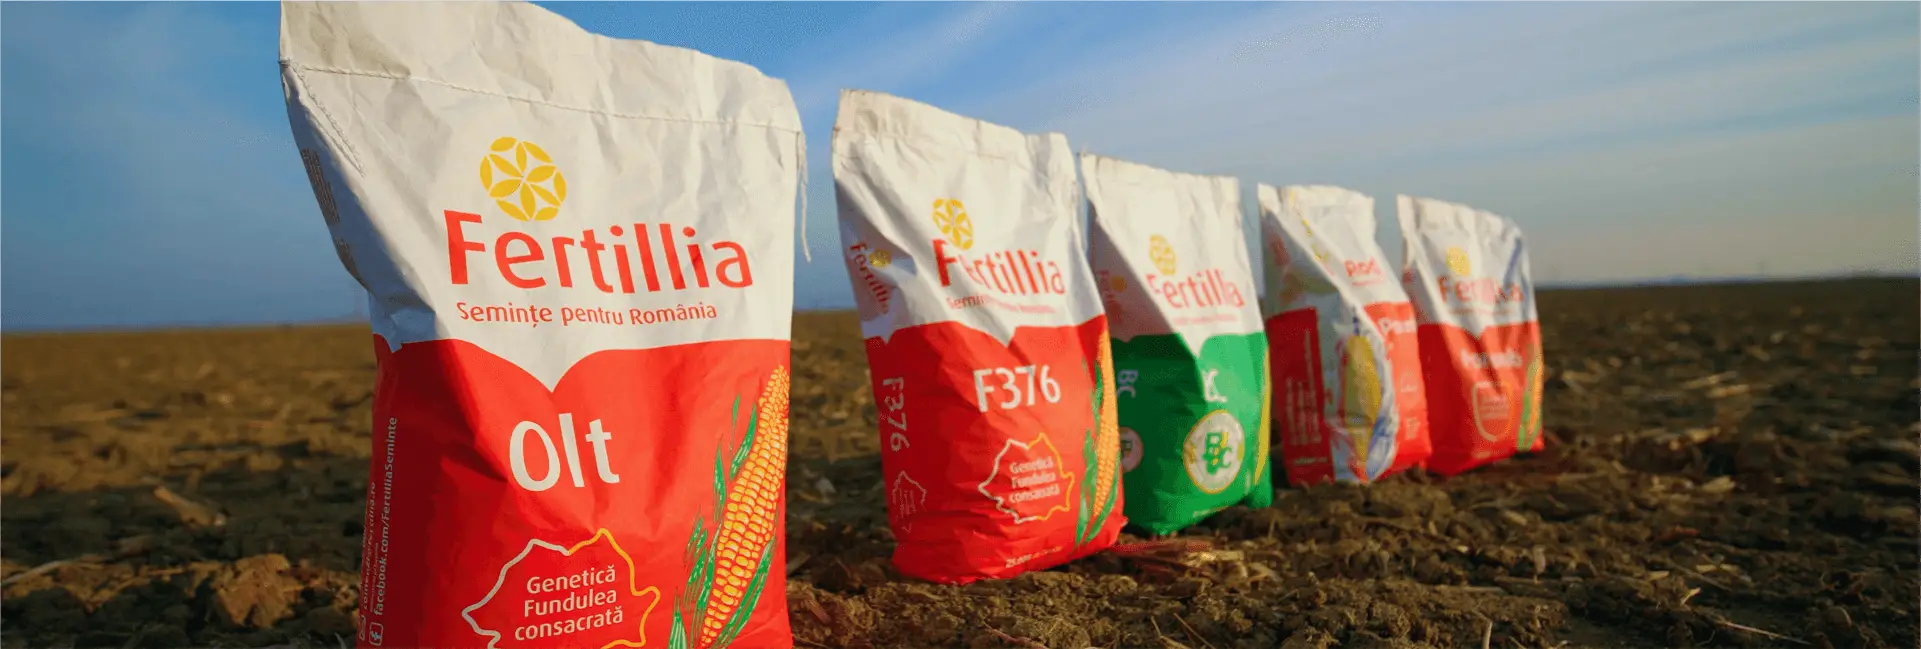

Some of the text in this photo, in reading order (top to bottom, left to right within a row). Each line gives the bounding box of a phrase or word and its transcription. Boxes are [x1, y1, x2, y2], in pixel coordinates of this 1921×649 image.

[444, 209, 753, 294] Fertillia
[456, 301, 717, 328] Semințe pentru România
[973, 364, 1061, 412] F376
[883, 377, 910, 452] F376
[509, 413, 620, 492] Olt
[526, 565, 617, 595] Genetică
[523, 587, 618, 618] Fundulea
[514, 607, 624, 642] consacrată
